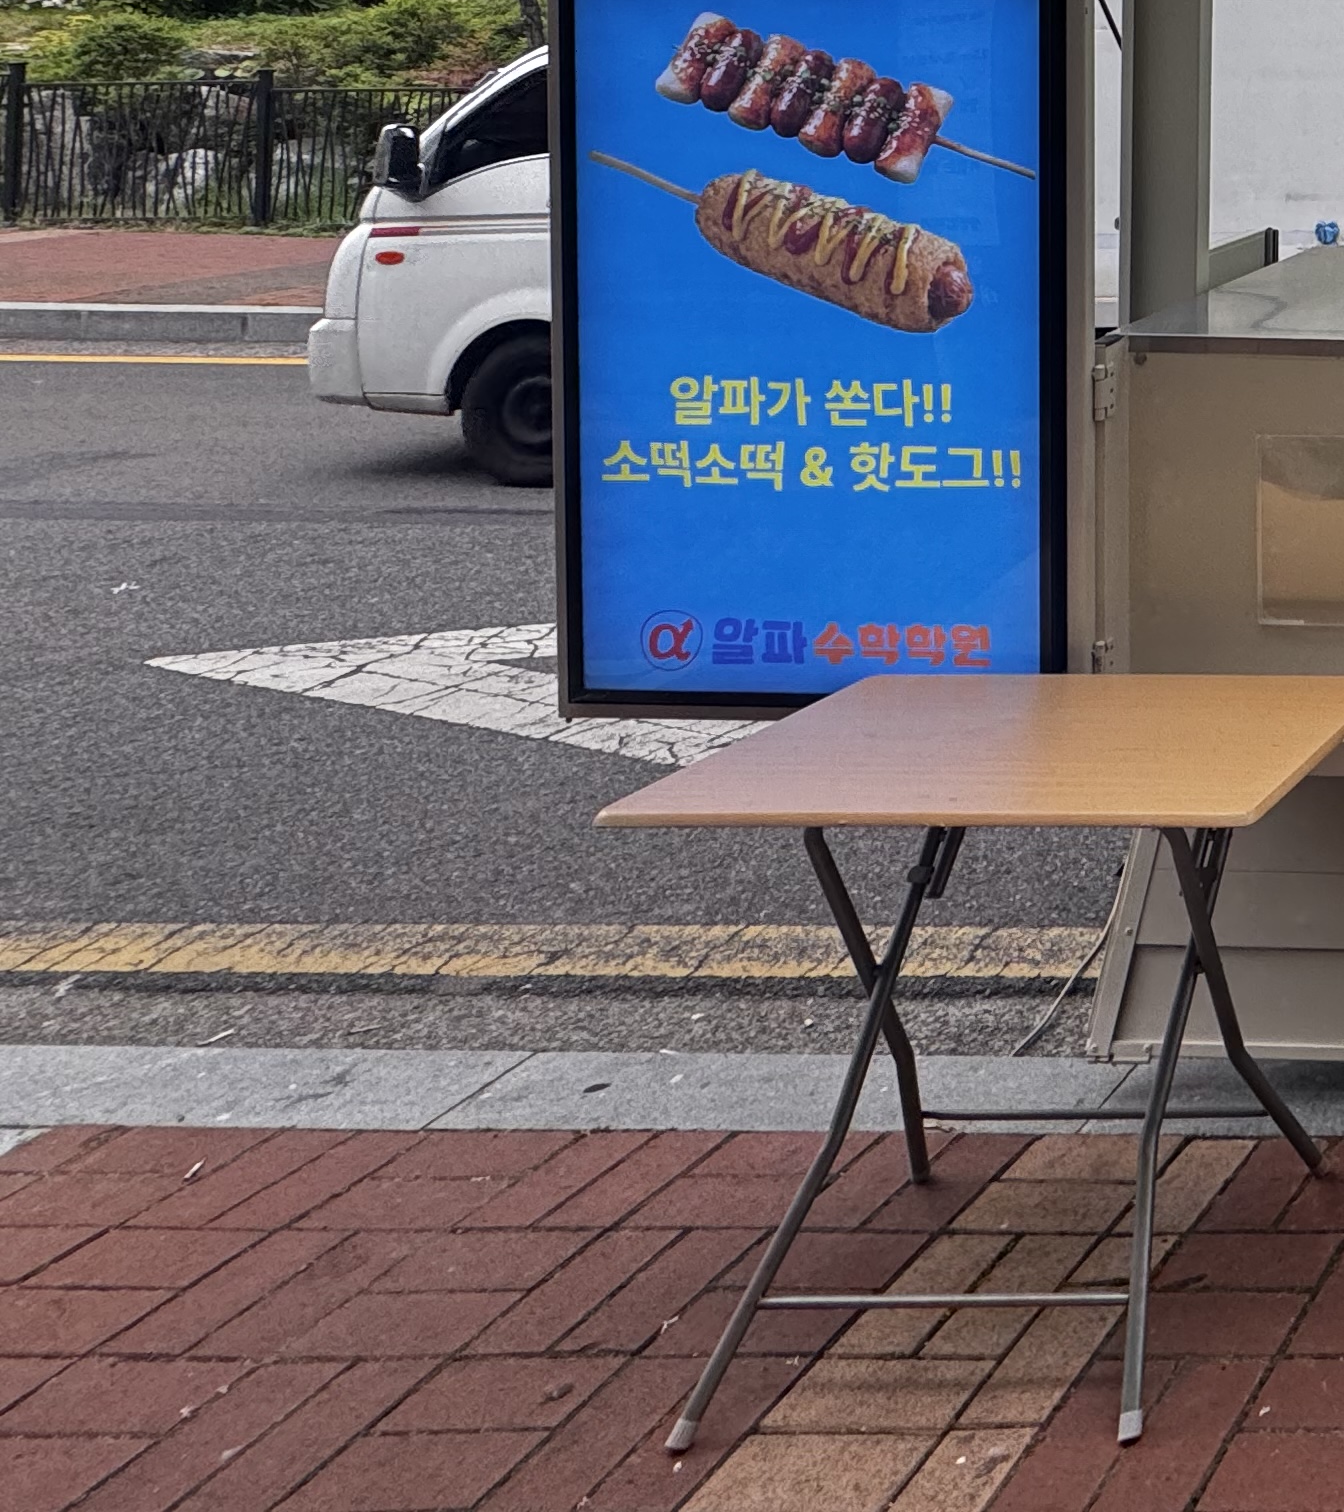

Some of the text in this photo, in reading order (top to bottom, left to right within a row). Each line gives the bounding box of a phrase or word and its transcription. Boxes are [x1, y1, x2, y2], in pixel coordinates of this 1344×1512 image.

[668, 375, 953, 428] 알파가 쏜다!!
[601, 440, 1023, 492] 소떡소떡 & 핫도그!!
